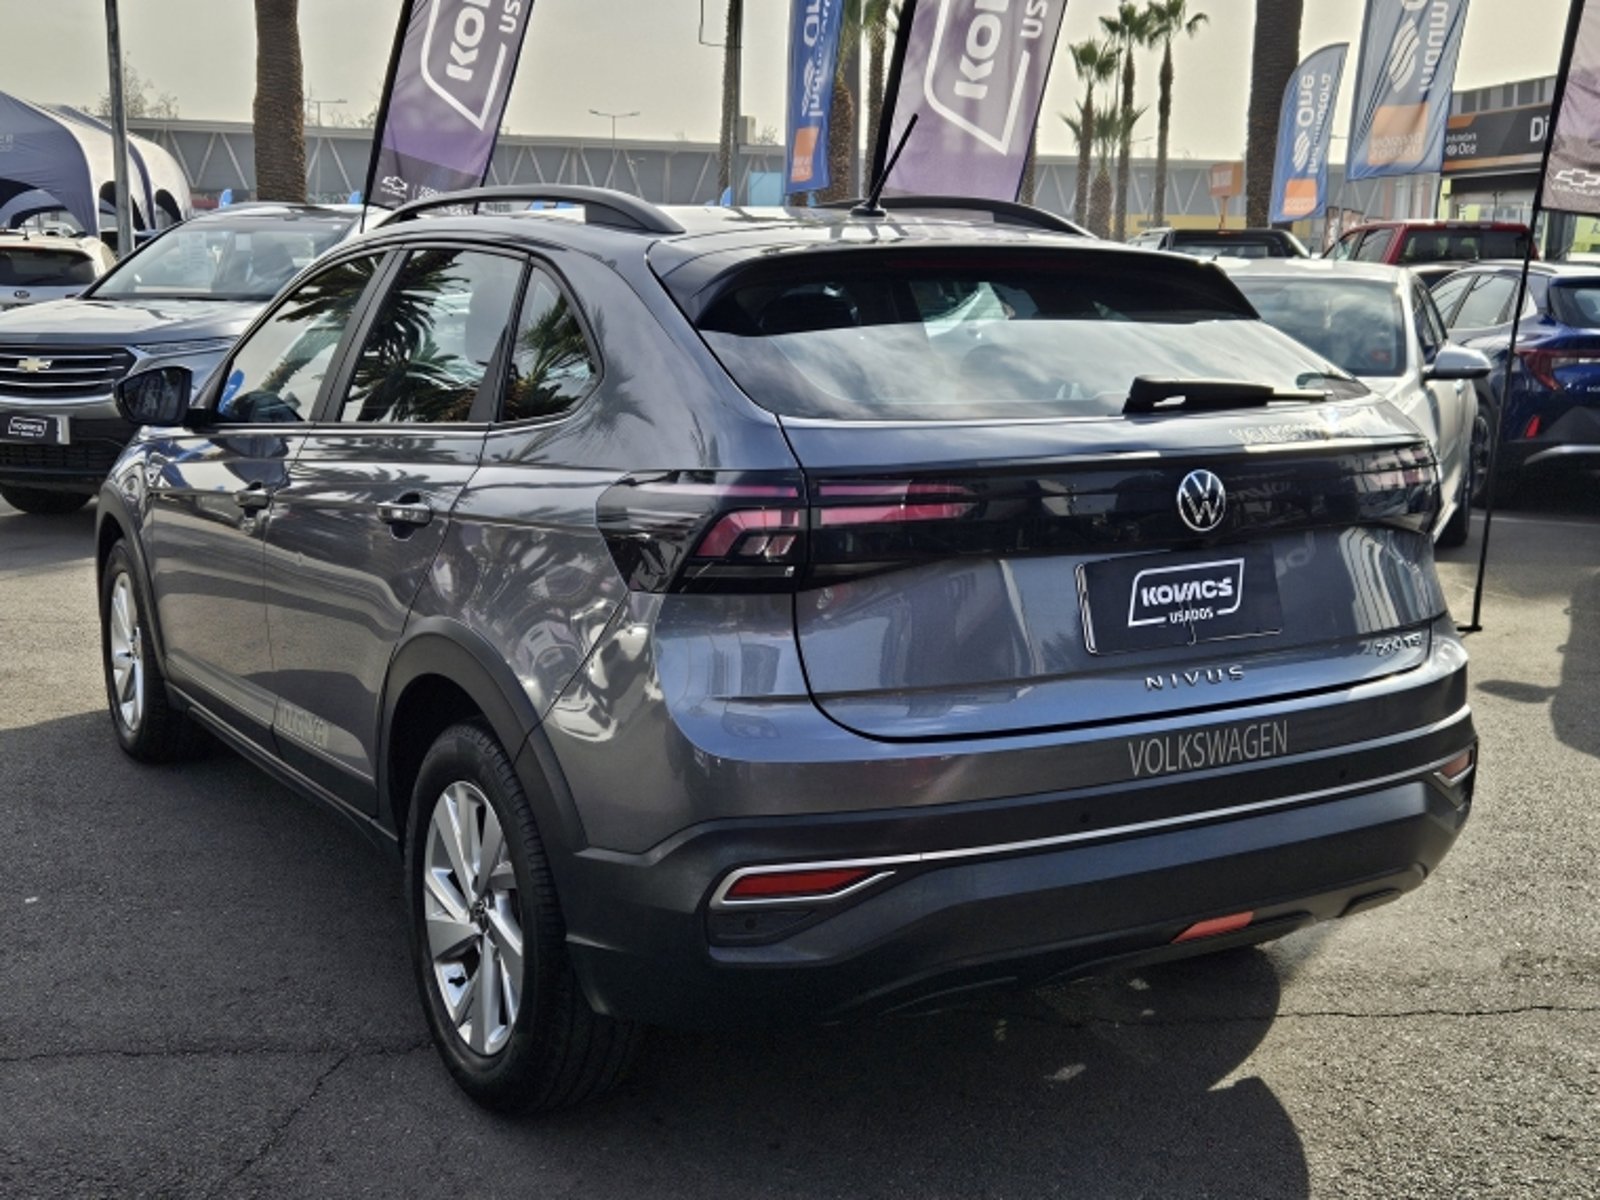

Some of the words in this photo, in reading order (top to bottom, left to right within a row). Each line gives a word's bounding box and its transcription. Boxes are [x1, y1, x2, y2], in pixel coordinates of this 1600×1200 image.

[446, 0, 491, 82] KO
[1141, 577, 1233, 607] KOVACS
[1168, 606, 1214, 624] USADOS
[1144, 664, 1244, 692] NIVUS
[1128, 719, 1288, 777] VOLKSWAGEN
